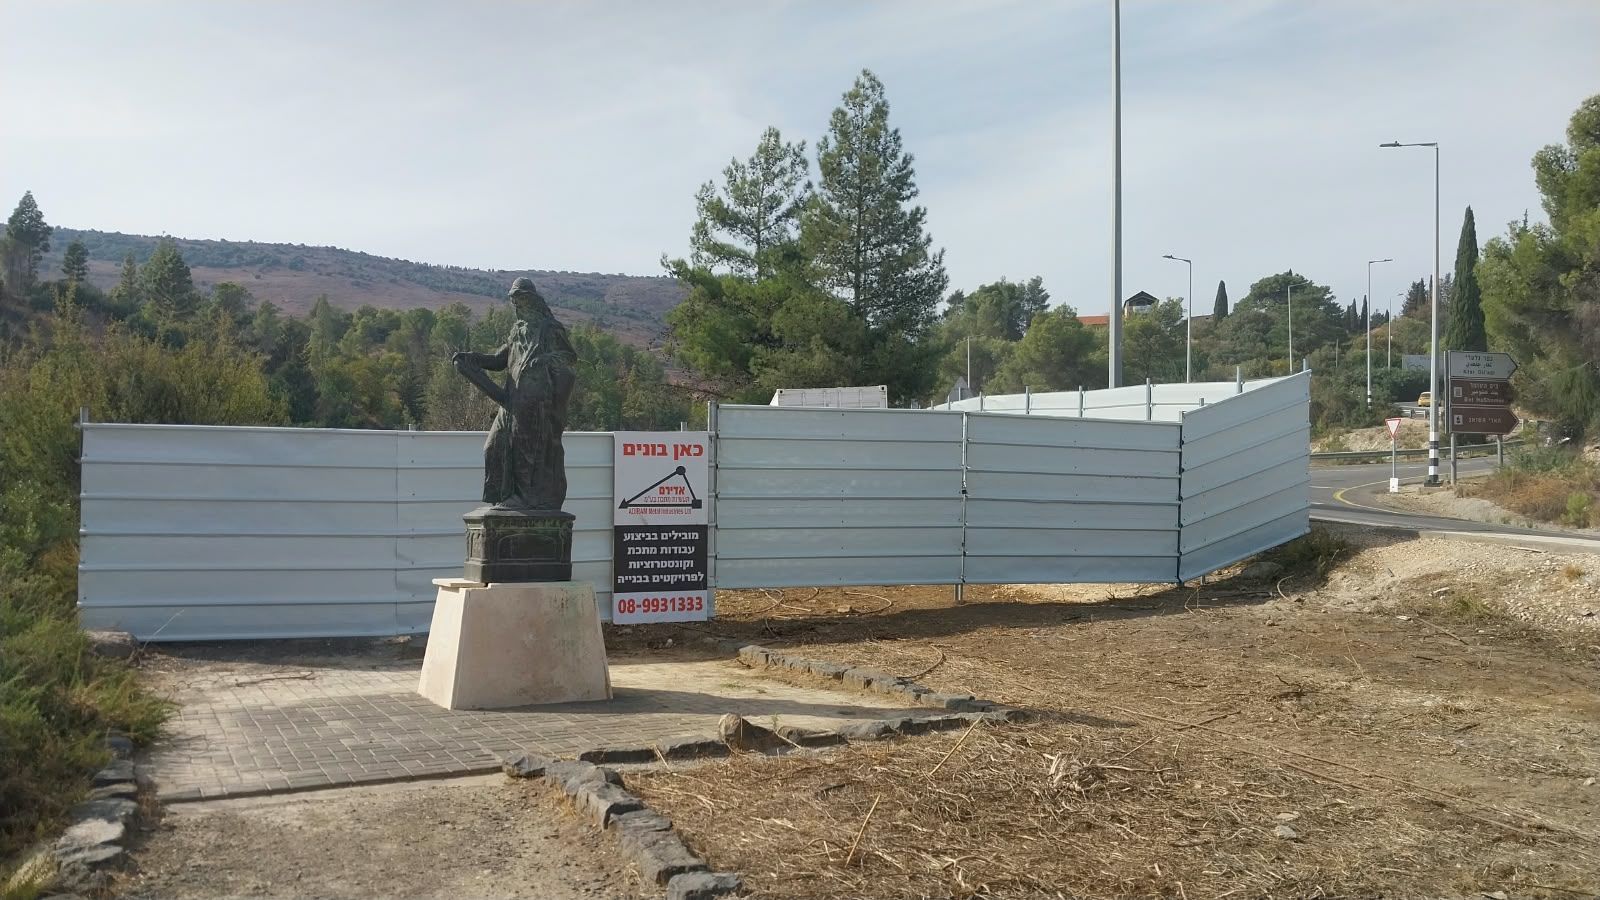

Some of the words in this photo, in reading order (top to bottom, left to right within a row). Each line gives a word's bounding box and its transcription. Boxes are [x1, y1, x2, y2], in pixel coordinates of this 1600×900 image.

[623, 443, 668, 456] בונים
[673, 443, 704, 460] כאן
[659, 486, 685, 495] אדירם
[623, 532, 658, 541] בביצוע
[660, 530, 699, 540] מובילים
[627, 546, 658, 555] מתכת
[660, 546, 695, 554] עבודות
[628, 560, 694, 570] וקונסטרוציות
[617, 575, 650, 583] בבנייה
[652, 571, 704, 584] לפרויקטים
[617, 596, 703, 614] 08-9931333
